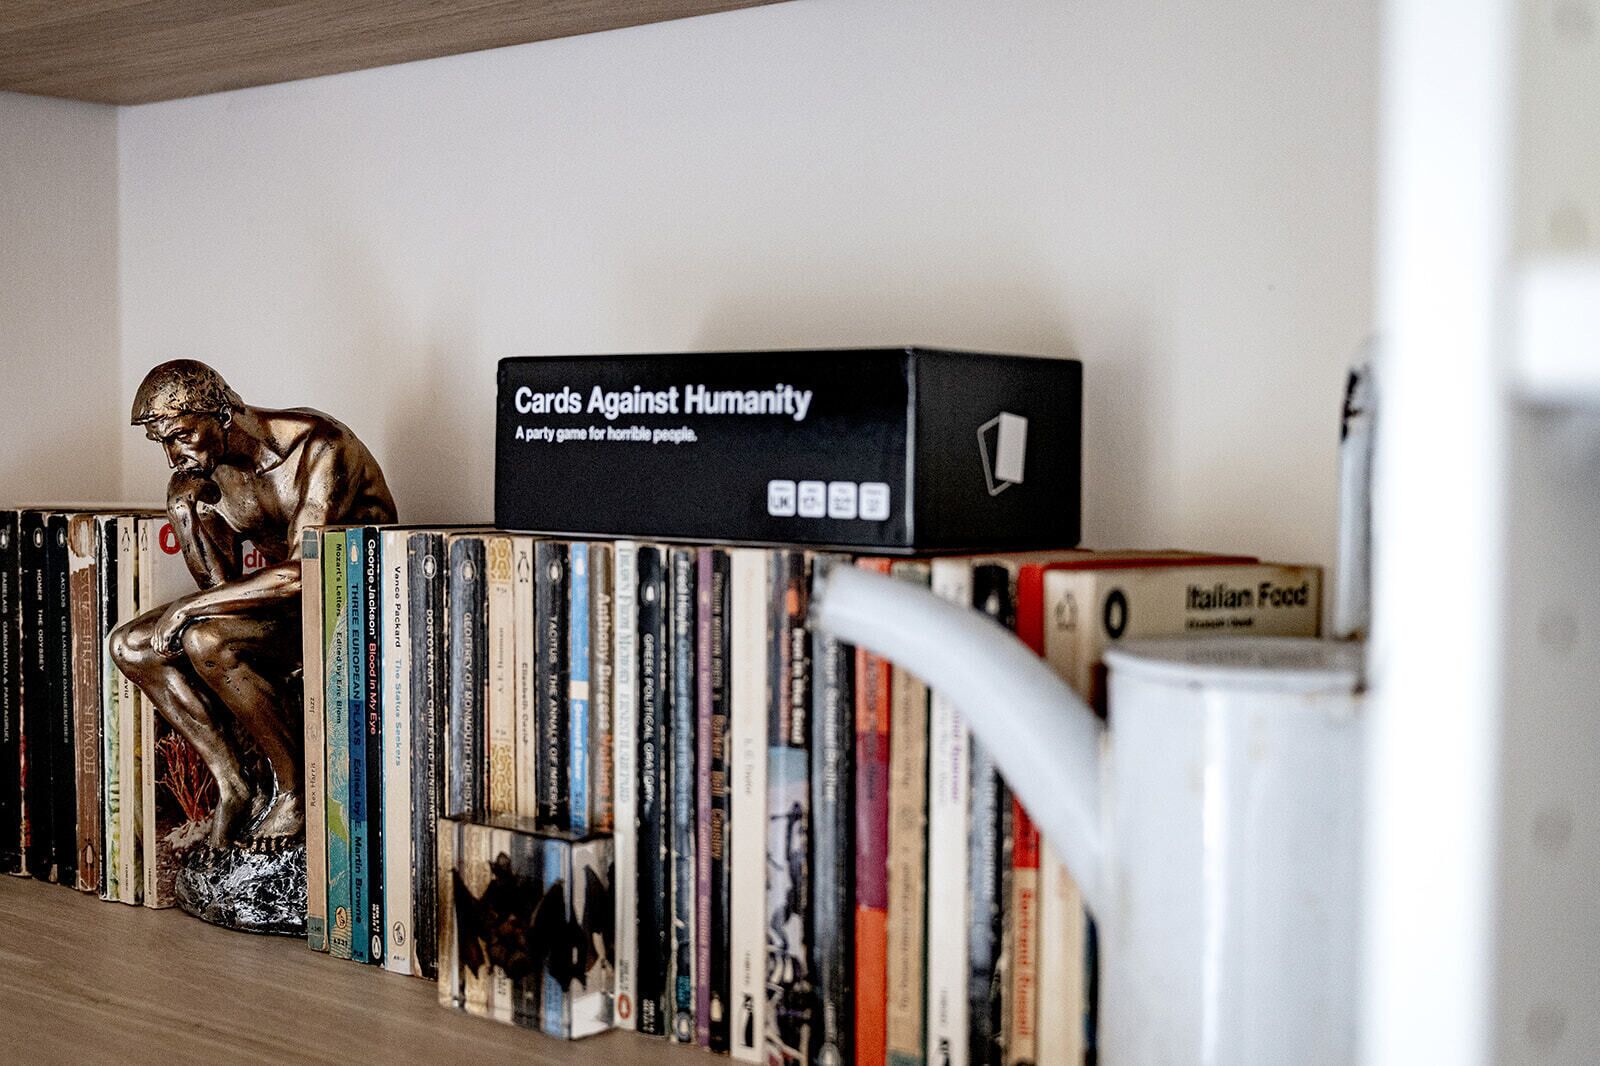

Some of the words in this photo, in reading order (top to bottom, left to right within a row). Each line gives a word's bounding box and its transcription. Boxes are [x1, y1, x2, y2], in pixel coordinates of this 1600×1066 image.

[515, 386, 582, 413] Cards
[586, 385, 679, 420] Against
[684, 383, 813, 421] Humanity
[515, 426, 525, 439] A
[525, 426, 555, 442] party
[556, 428, 587, 443] game
[588, 426, 606, 440] for
[607, 426, 652, 441] horrible
[367, 539, 376, 583] George
[351, 584, 359, 625] THREE
[368, 585, 376, 636] Jackson
[1186, 583, 1253, 610] Italian
[1257, 581, 1309, 608] Food
[463, 612, 472, 671] GEOFFREY
[549, 615, 558, 664] TACITUS
[596, 592, 611, 661] Anthony
[335, 665, 343, 676] by
[352, 629, 360, 699] EUROPEAN
[426, 609, 434, 689] DOSTOYEVSKY
[643, 633, 654, 676] GREEK
[368, 692, 377, 711] My
[369, 679, 376, 689] in
[464, 673, 472, 687] OF
[549, 674, 558, 695] THE
[353, 703, 361, 746] PLAYS
[368, 712, 377, 735] Eye
[464, 691, 473, 754] MONMOUTH
[549, 699, 558, 744] ANNALS
[643, 678, 654, 741] POLITICAL
[550, 747, 558, 763] OF
[643, 743, 655, 801] ORATORY
[353, 801, 361, 816] by
[550, 767, 559, 817] IMPERIAL
[354, 819, 361, 831] E.
